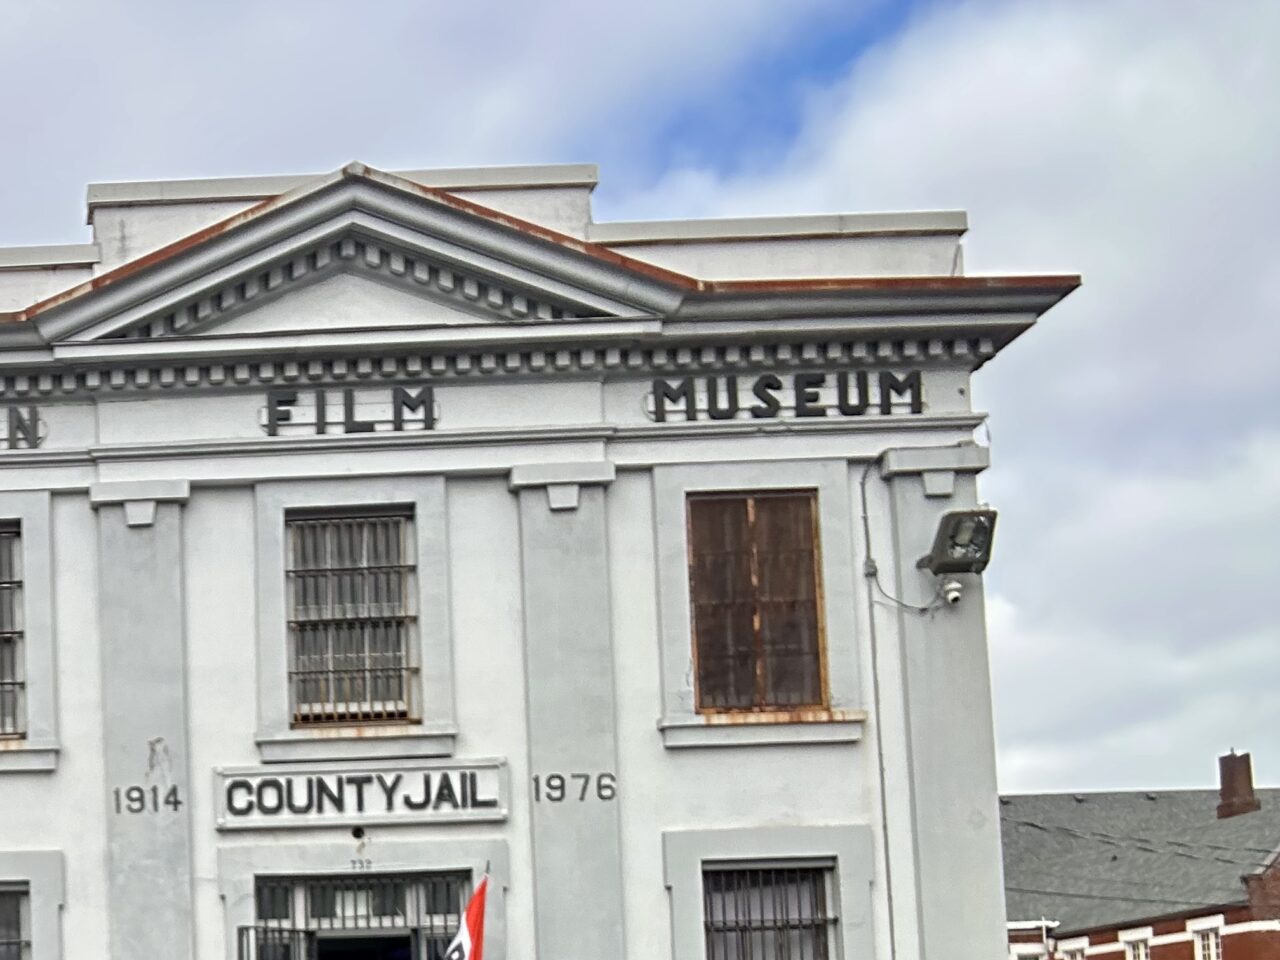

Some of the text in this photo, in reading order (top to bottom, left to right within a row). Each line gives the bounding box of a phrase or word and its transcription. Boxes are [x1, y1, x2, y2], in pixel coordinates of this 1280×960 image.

[267, 388, 437, 436] FILM
[652, 369, 923, 423] MUSEUM
[113, 784, 183, 815] 1914
[226, 769, 498, 817] COUNTY JAIL
[532, 772, 616, 803] 1976
